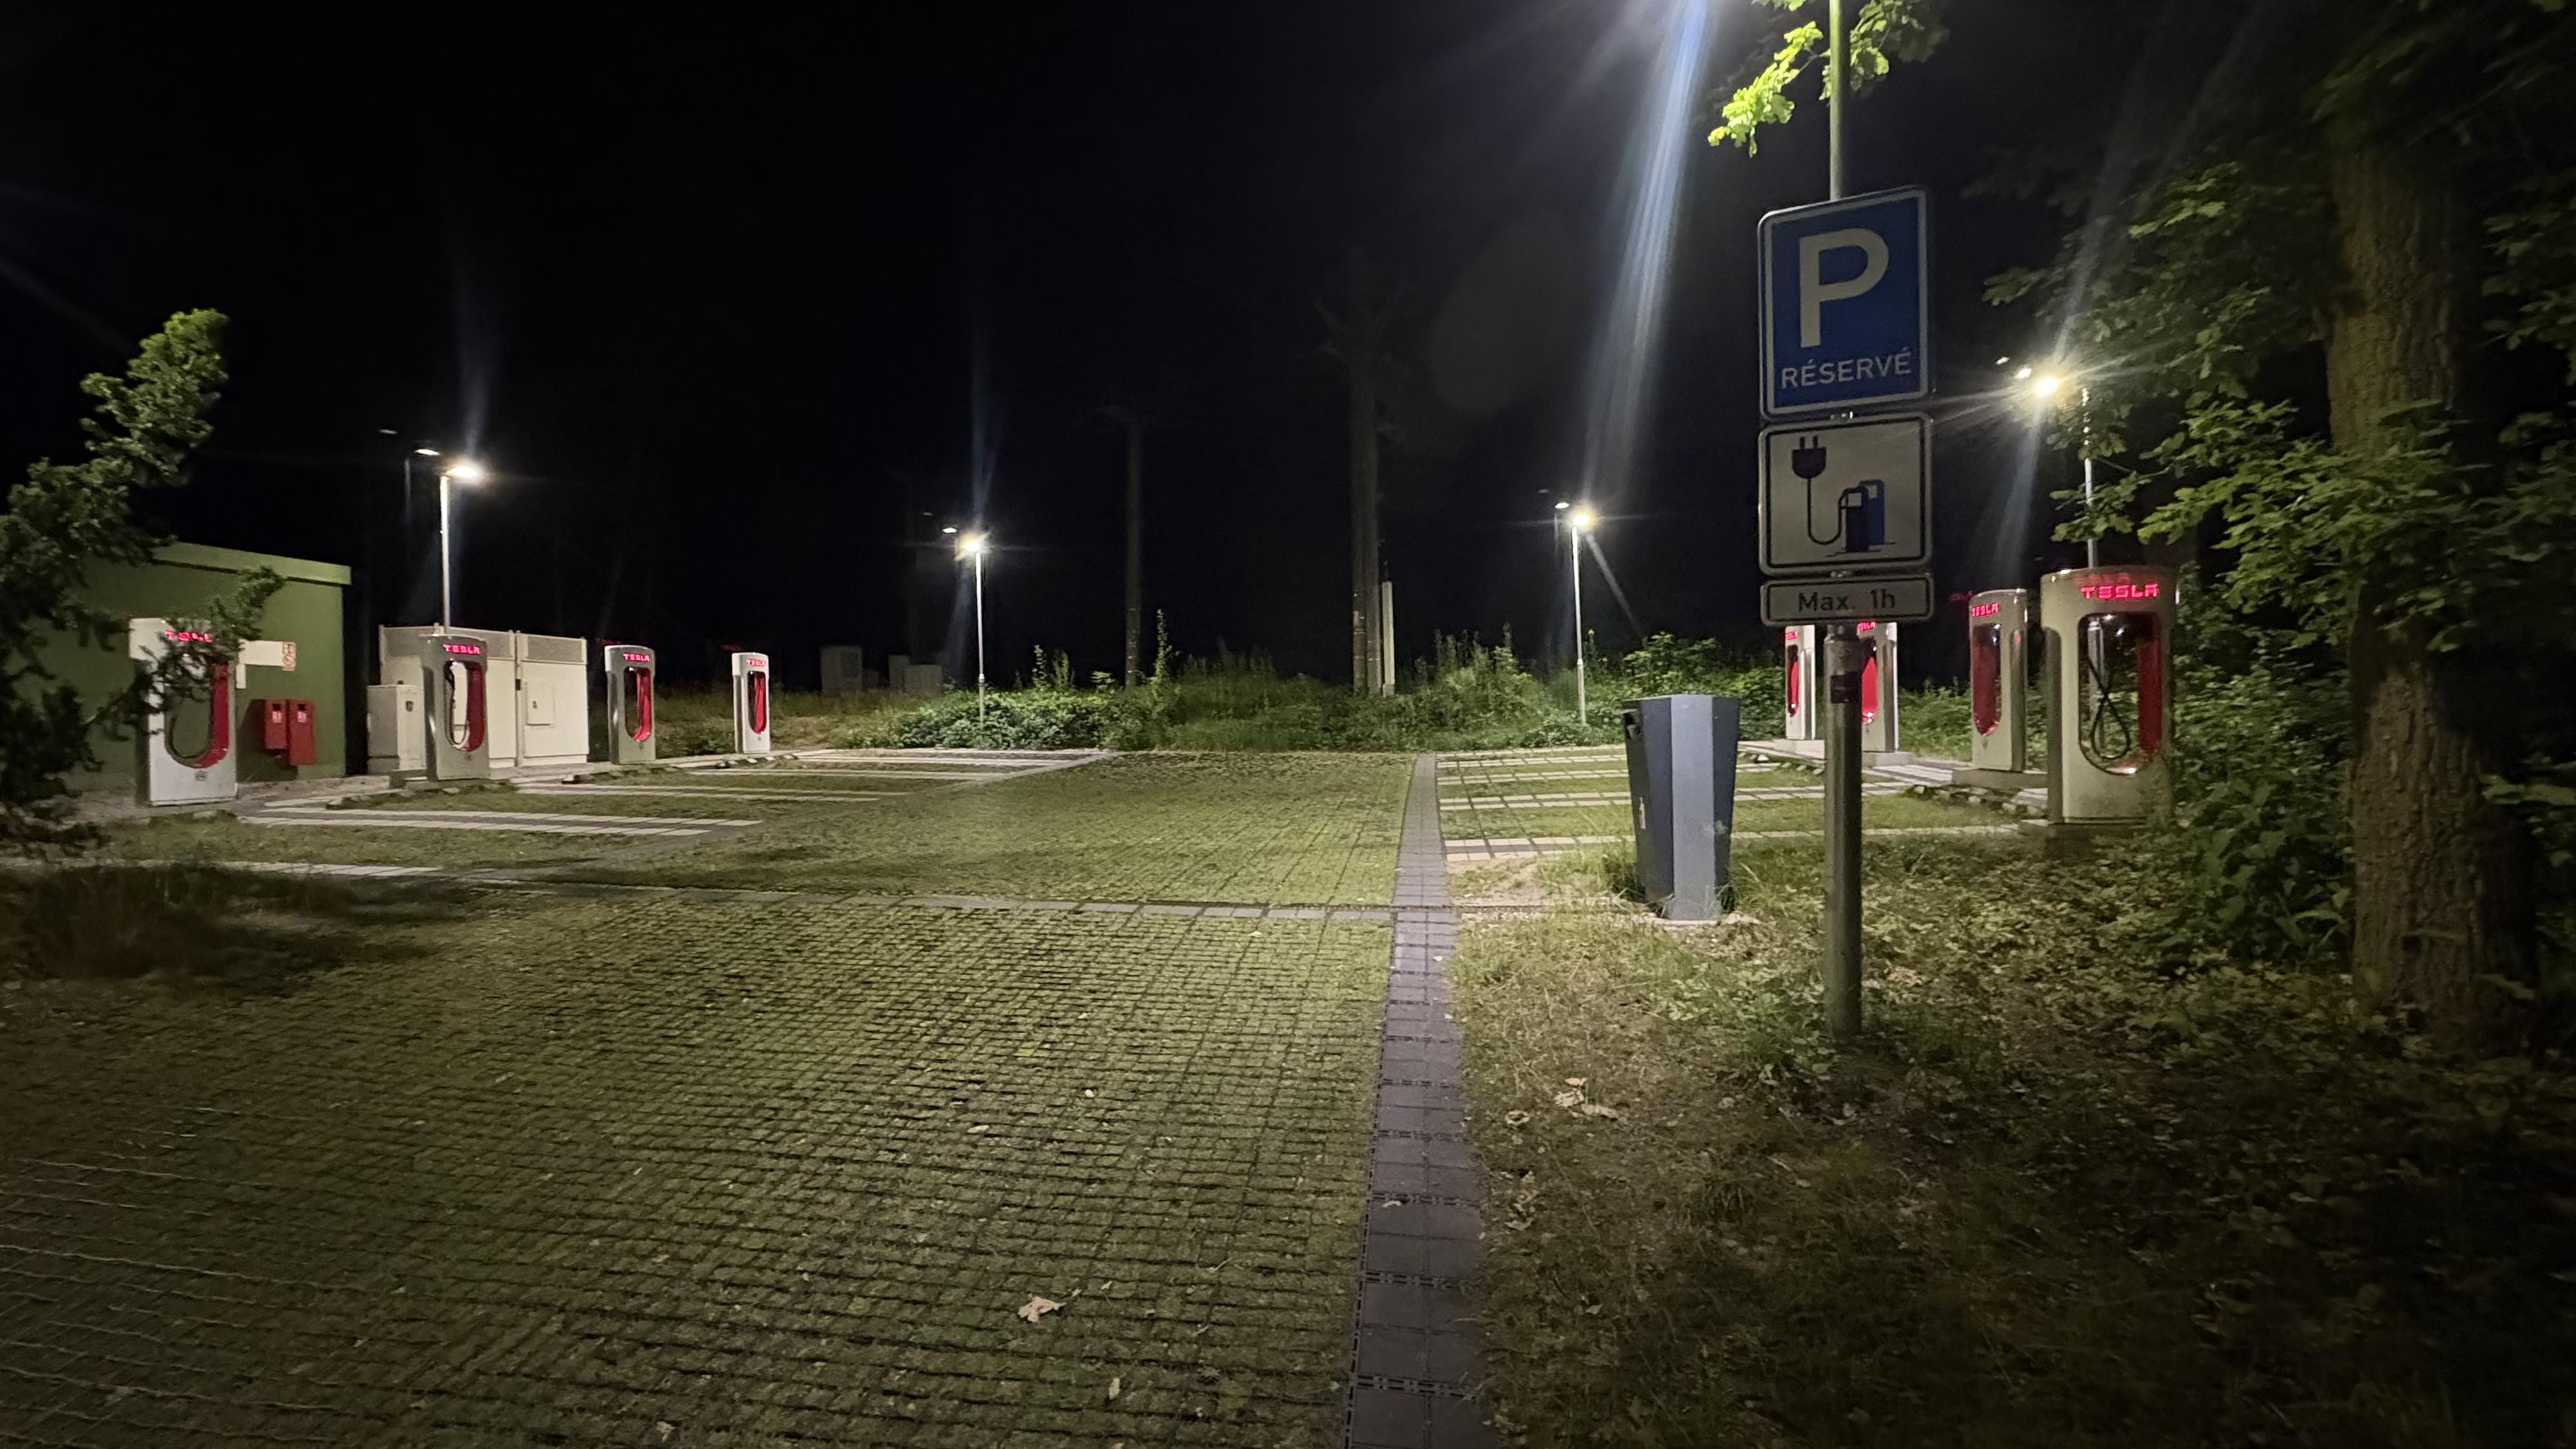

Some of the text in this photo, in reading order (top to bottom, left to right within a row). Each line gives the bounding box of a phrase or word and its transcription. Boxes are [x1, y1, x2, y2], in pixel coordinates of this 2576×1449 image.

[1799, 227, 1889, 348] P
[1781, 346, 1911, 390] RÉSERVÉ
[2079, 582, 2158, 600] TESLA
[1798, 589, 1896, 612] Max. 1h
[1971, 602, 1999, 617] TESLA
[442, 643, 481, 654] TESLA
[622, 652, 650, 662] TESLA
